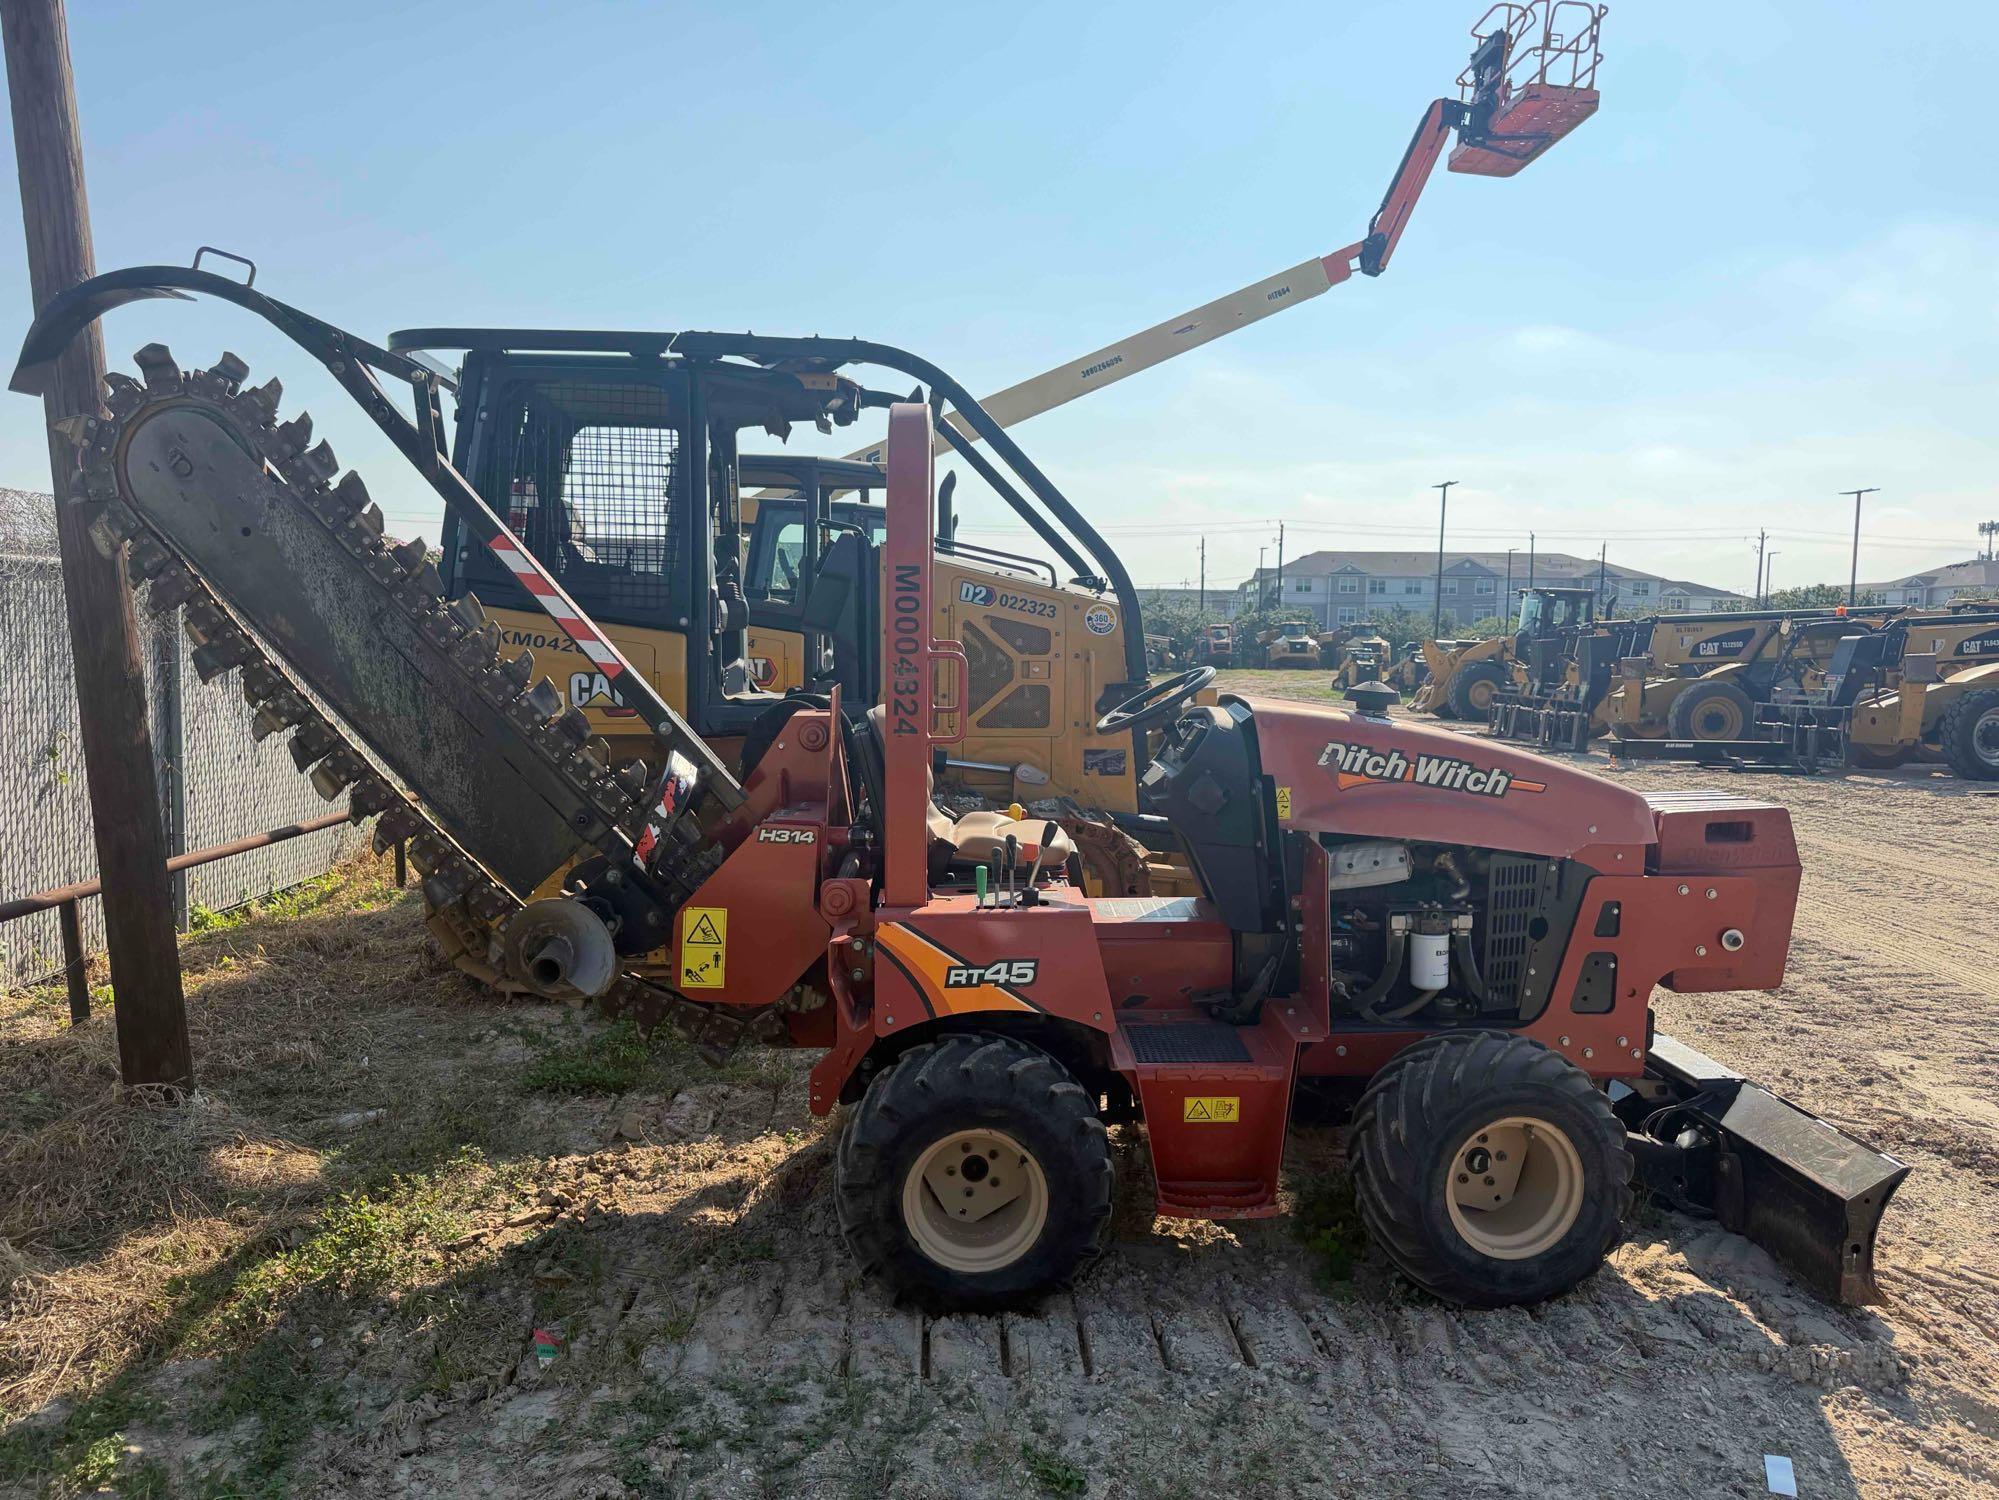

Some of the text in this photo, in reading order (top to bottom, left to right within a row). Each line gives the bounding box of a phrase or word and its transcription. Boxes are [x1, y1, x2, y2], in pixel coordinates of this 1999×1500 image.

[960, 582, 1057, 619] D2 022323
[501, 631, 583, 654] KM042
[1700, 642, 1719, 655] CAT
[1963, 641, 1981, 654] CAT
[571, 673, 624, 707] CA
[1416, 755, 1510, 796] Witch
[759, 829, 815, 844] H314
[949, 962, 1035, 985] RT45
